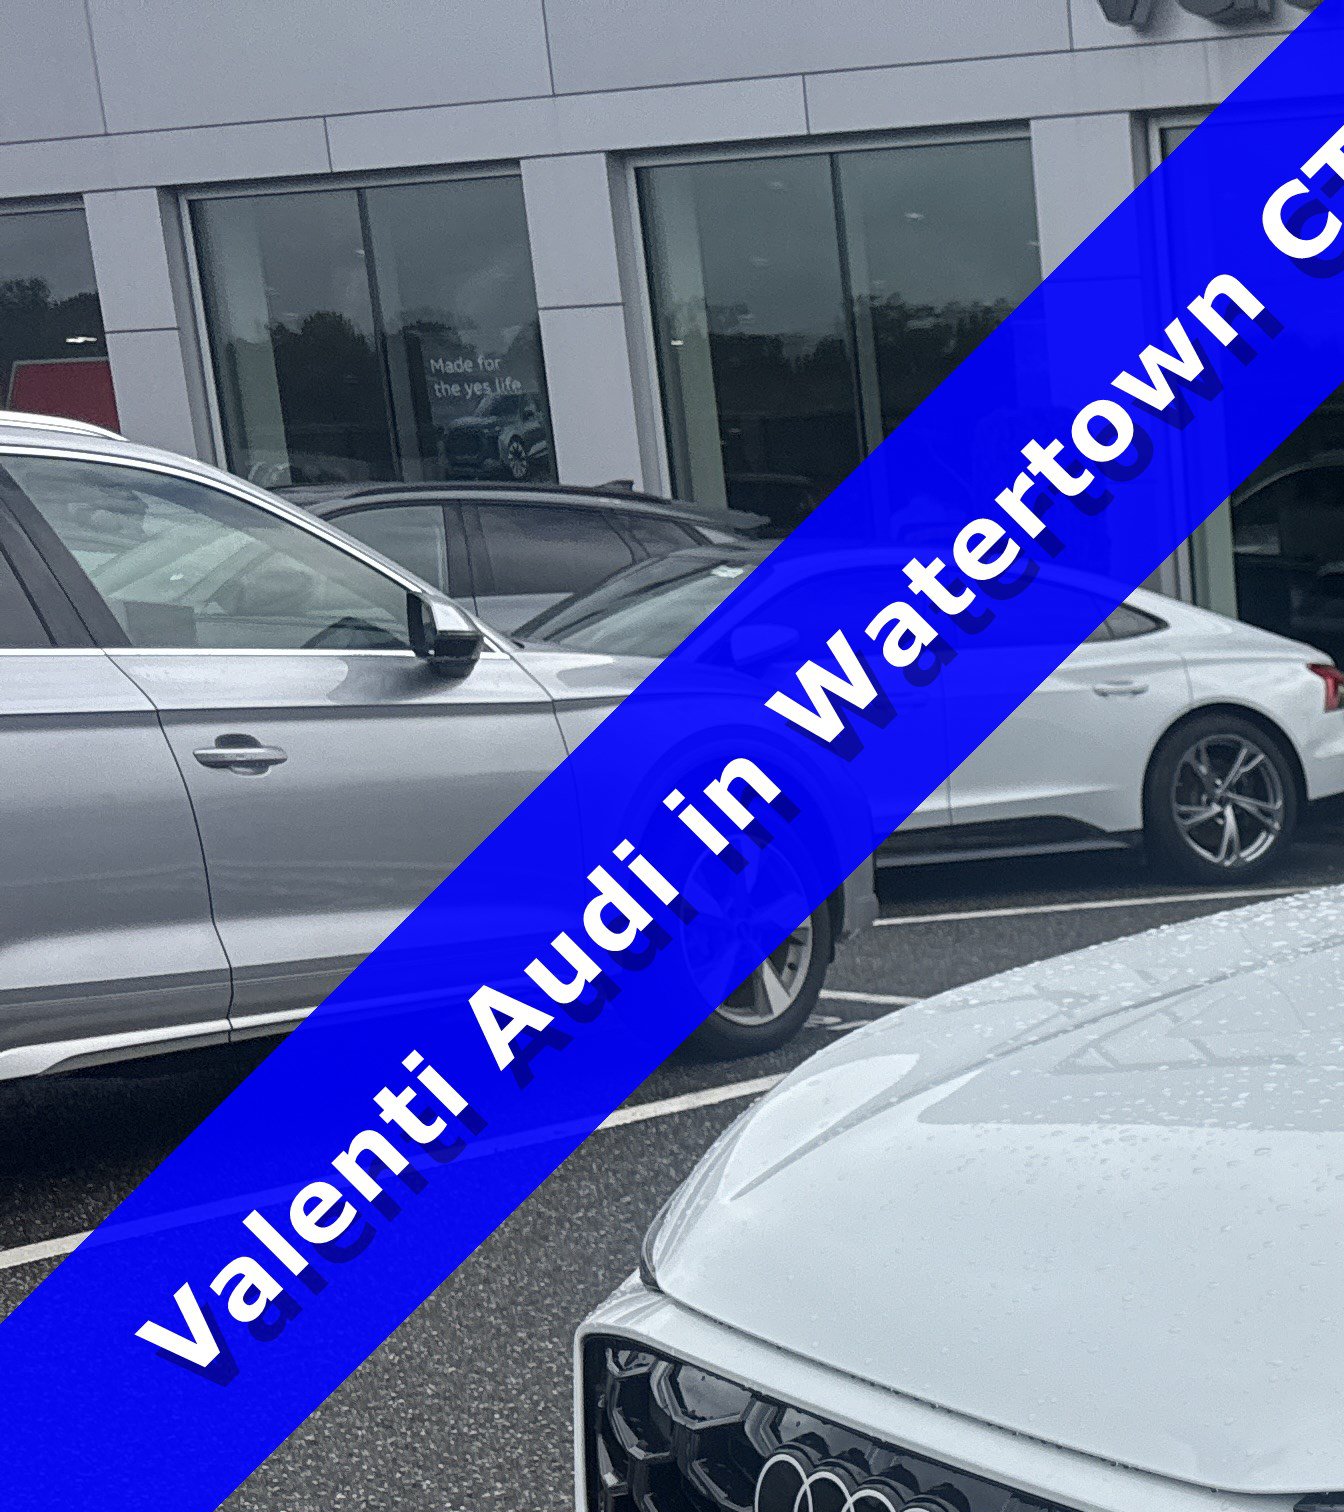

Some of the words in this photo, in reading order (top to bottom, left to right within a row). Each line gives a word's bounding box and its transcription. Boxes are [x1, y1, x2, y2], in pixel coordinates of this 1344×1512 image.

[430, 356, 473, 373] Made
[477, 355, 500, 372] for
[434, 381, 461, 397] the
[464, 382, 492, 399] yes
[495, 376, 522, 395] life
